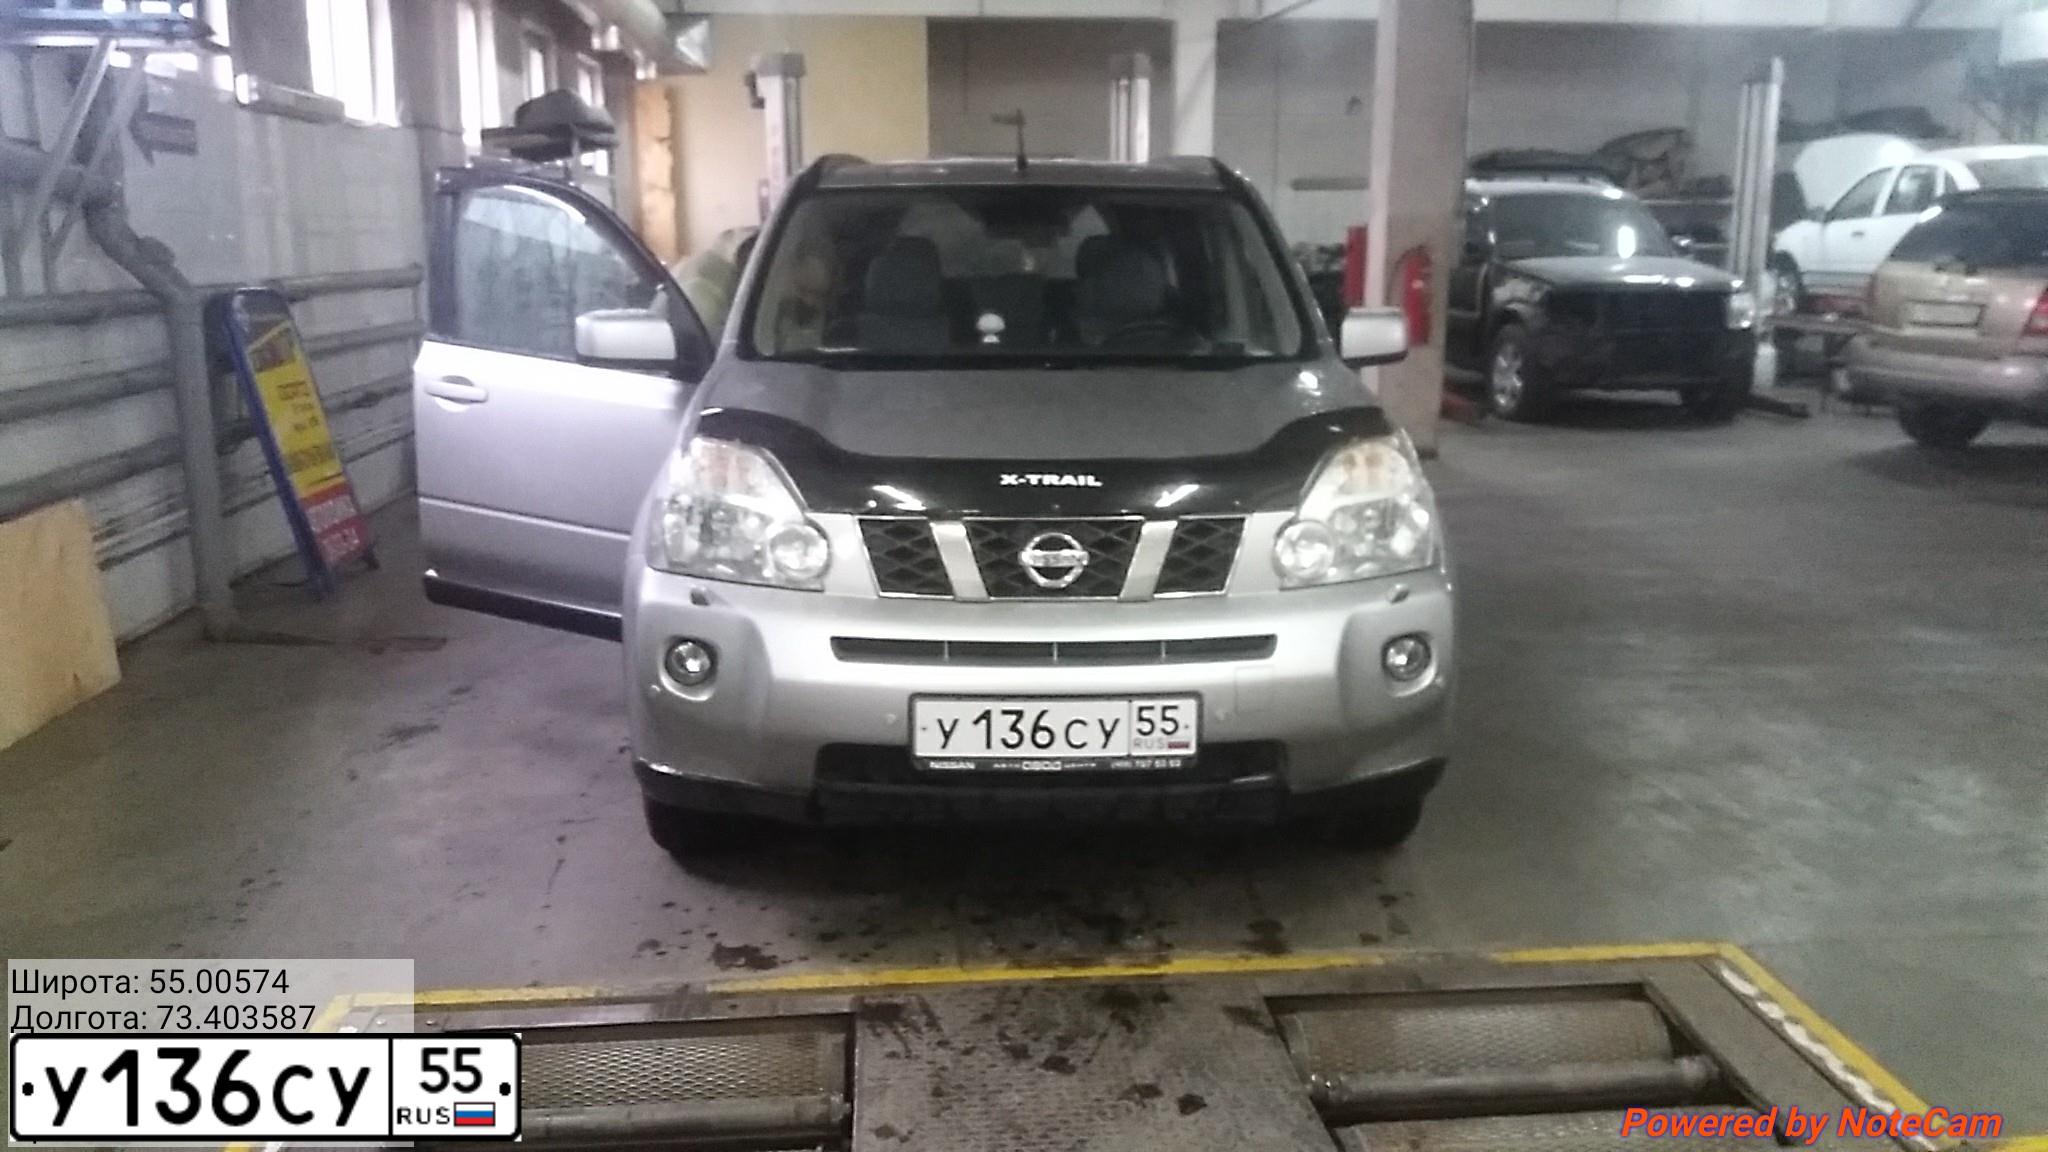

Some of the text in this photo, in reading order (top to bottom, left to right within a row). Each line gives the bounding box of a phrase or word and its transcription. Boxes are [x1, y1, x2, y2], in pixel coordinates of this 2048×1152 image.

[1000, 474, 1103, 487] X-TRAIL
[1137, 705, 1179, 736] 55
[1134, 737, 1165, 750] RUS
